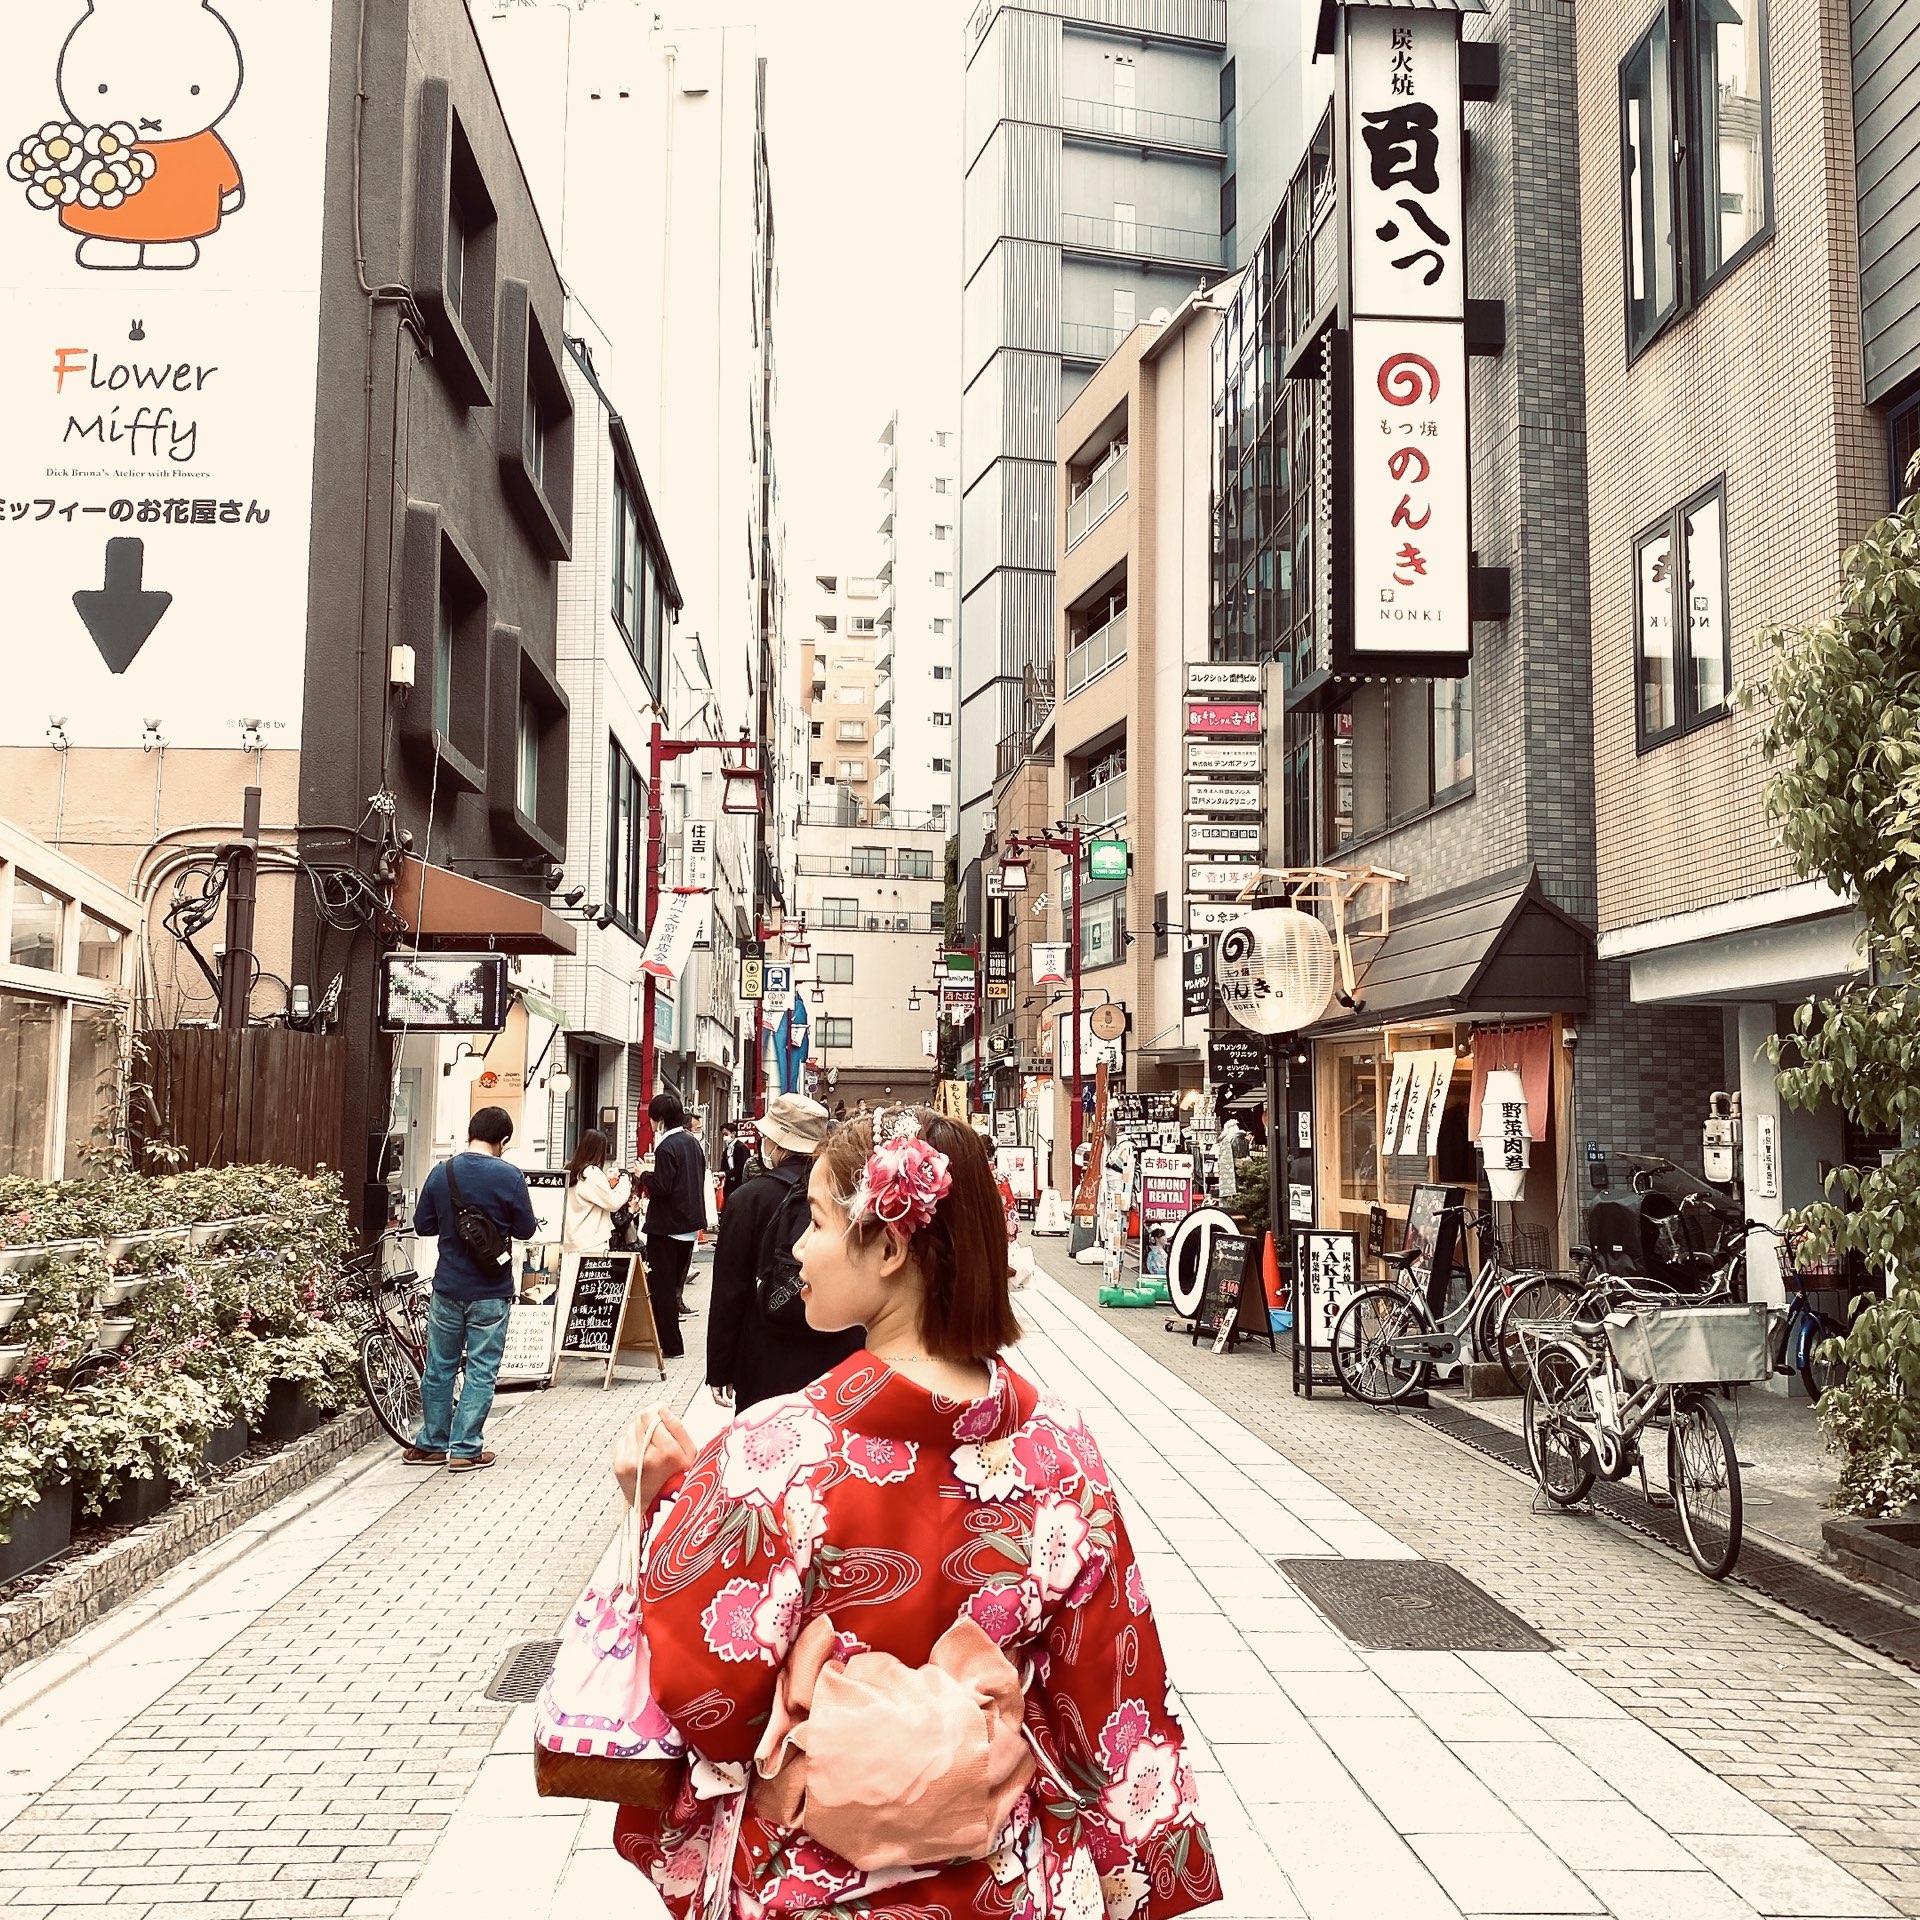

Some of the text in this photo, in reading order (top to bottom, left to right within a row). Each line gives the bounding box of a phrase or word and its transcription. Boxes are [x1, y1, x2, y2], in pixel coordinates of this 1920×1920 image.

[1391, 28, 1415, 96] 炭火焼
[1361, 102, 1450, 286] 百八つ
[53, 348, 219, 394] Flower
[63, 406, 198, 461] Miffy
[1380, 420, 1439, 437] もつ焼
[46, 468, 211, 478] Dick Bruna's Atelier with Flowers
[0, 498, 270, 524] ッフィーのお花屋さん
[1388, 447, 1431, 586] のんき
[1380, 610, 1442, 621] NONKI
[691, 825, 706, 853] 住吉
[948, 975, 975, 983] amilyMar
[1222, 978, 1271, 1000] のんき
[1385, 1076, 1404, 1135] ハイボール
[1502, 1102, 1524, 1171] 野菜肉巻
[1147, 1178, 1187, 1190] KIMONO
[1148, 1191, 1185, 1203] RENTAL
[769, 1275, 805, 1311] adida
